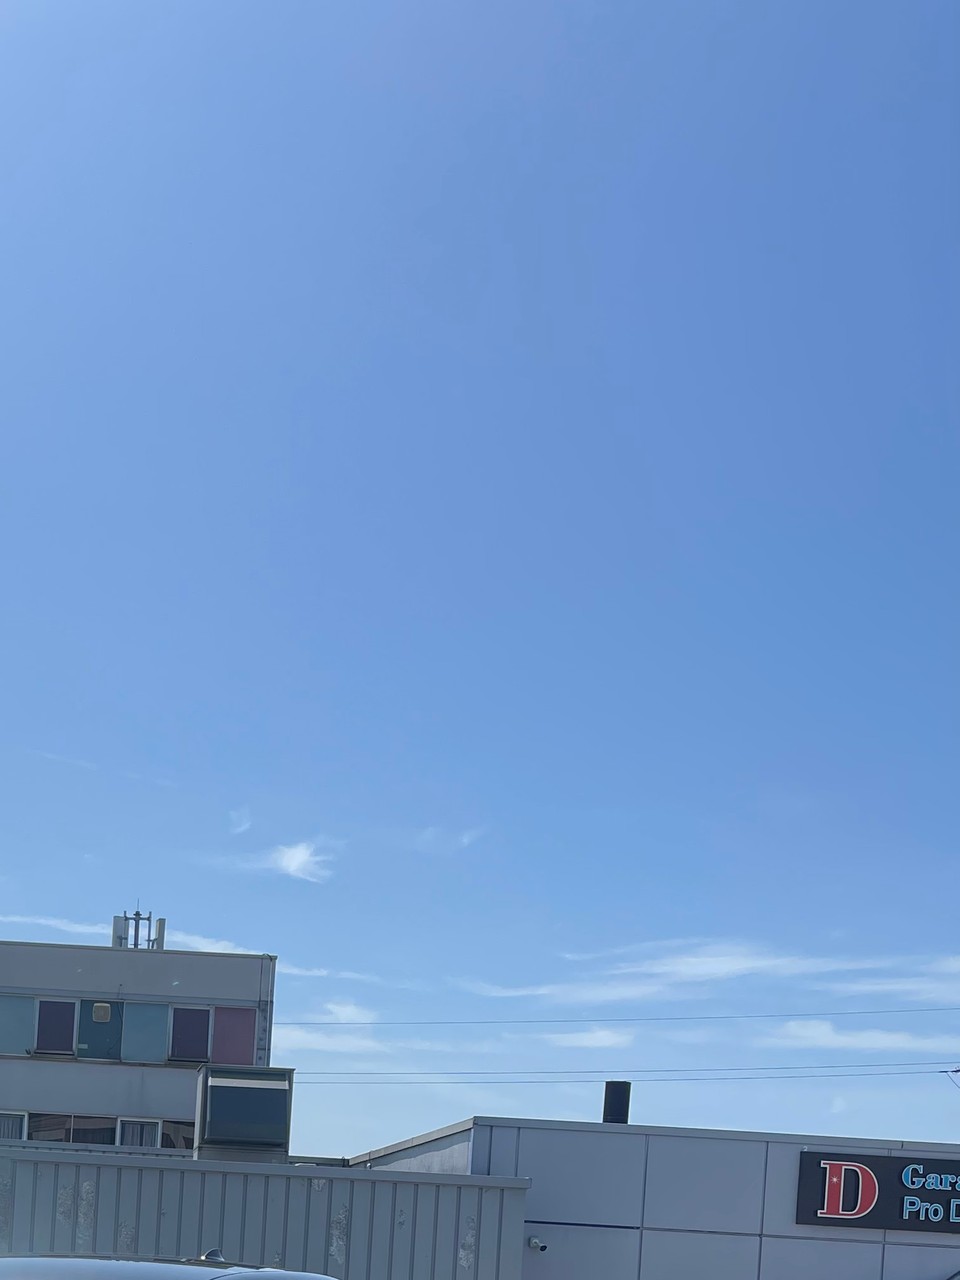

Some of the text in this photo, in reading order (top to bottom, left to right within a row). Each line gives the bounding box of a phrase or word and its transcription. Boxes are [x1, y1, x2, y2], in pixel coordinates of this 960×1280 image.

[817, 1160, 879, 1219] D
[902, 1164, 960, 1191] Gar
[903, 1196, 944, 1222] Pro
